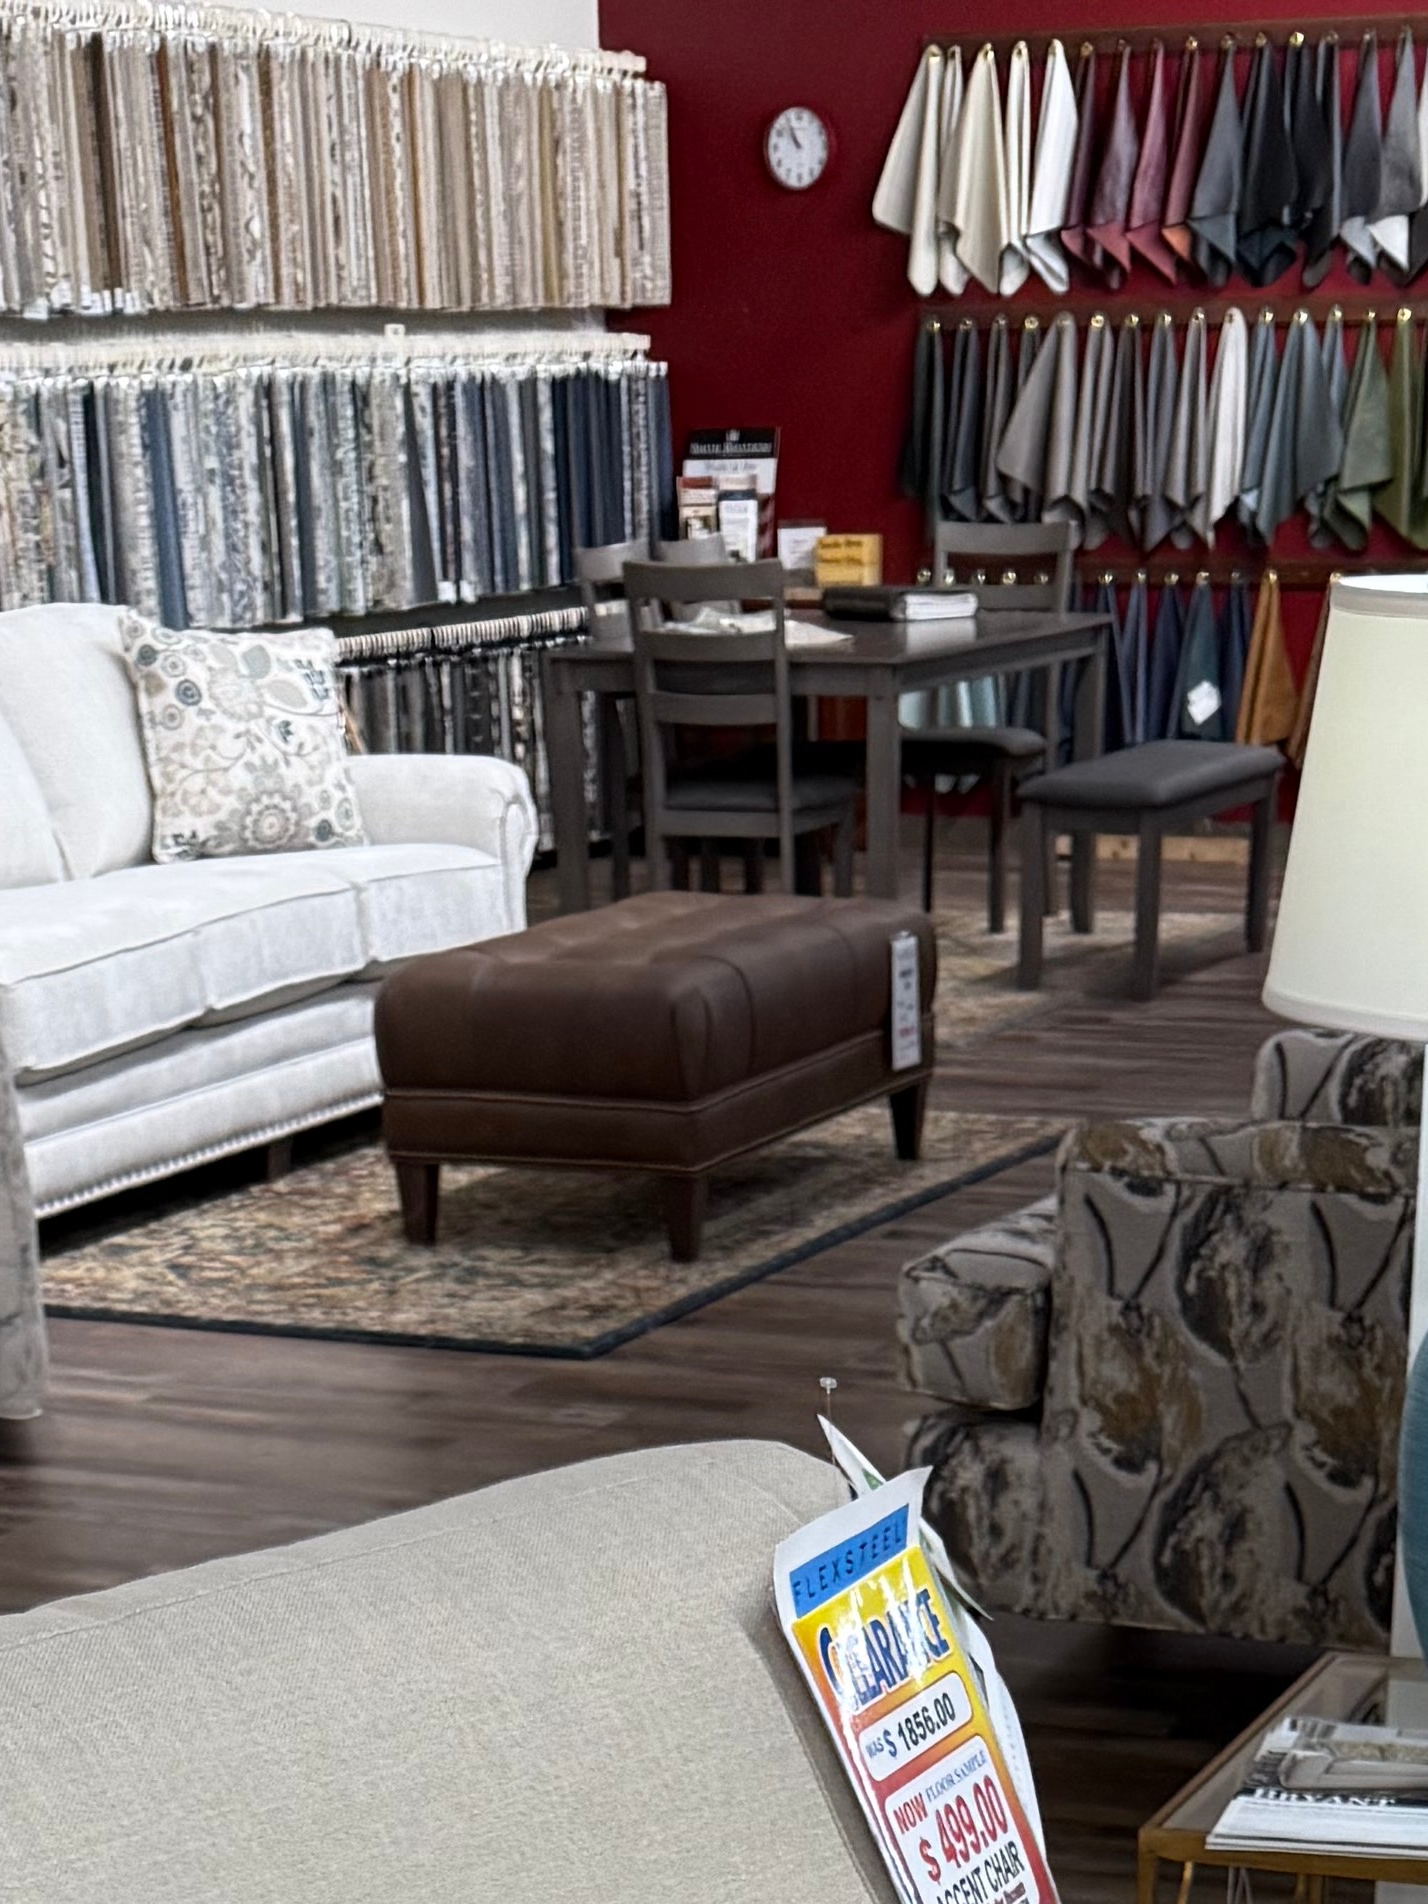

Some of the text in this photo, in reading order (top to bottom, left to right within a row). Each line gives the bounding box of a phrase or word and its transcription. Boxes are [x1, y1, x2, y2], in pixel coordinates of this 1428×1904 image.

[793, 1523, 902, 1605] FLEXSTEEL
[883, 1729, 897, 1760] $
[898, 1692, 956, 1751] 1856.00
[893, 1792, 928, 1834] NOW
[919, 1775, 1008, 1885] $ 499.00
[984, 1840, 1025, 1892] CHAIR
